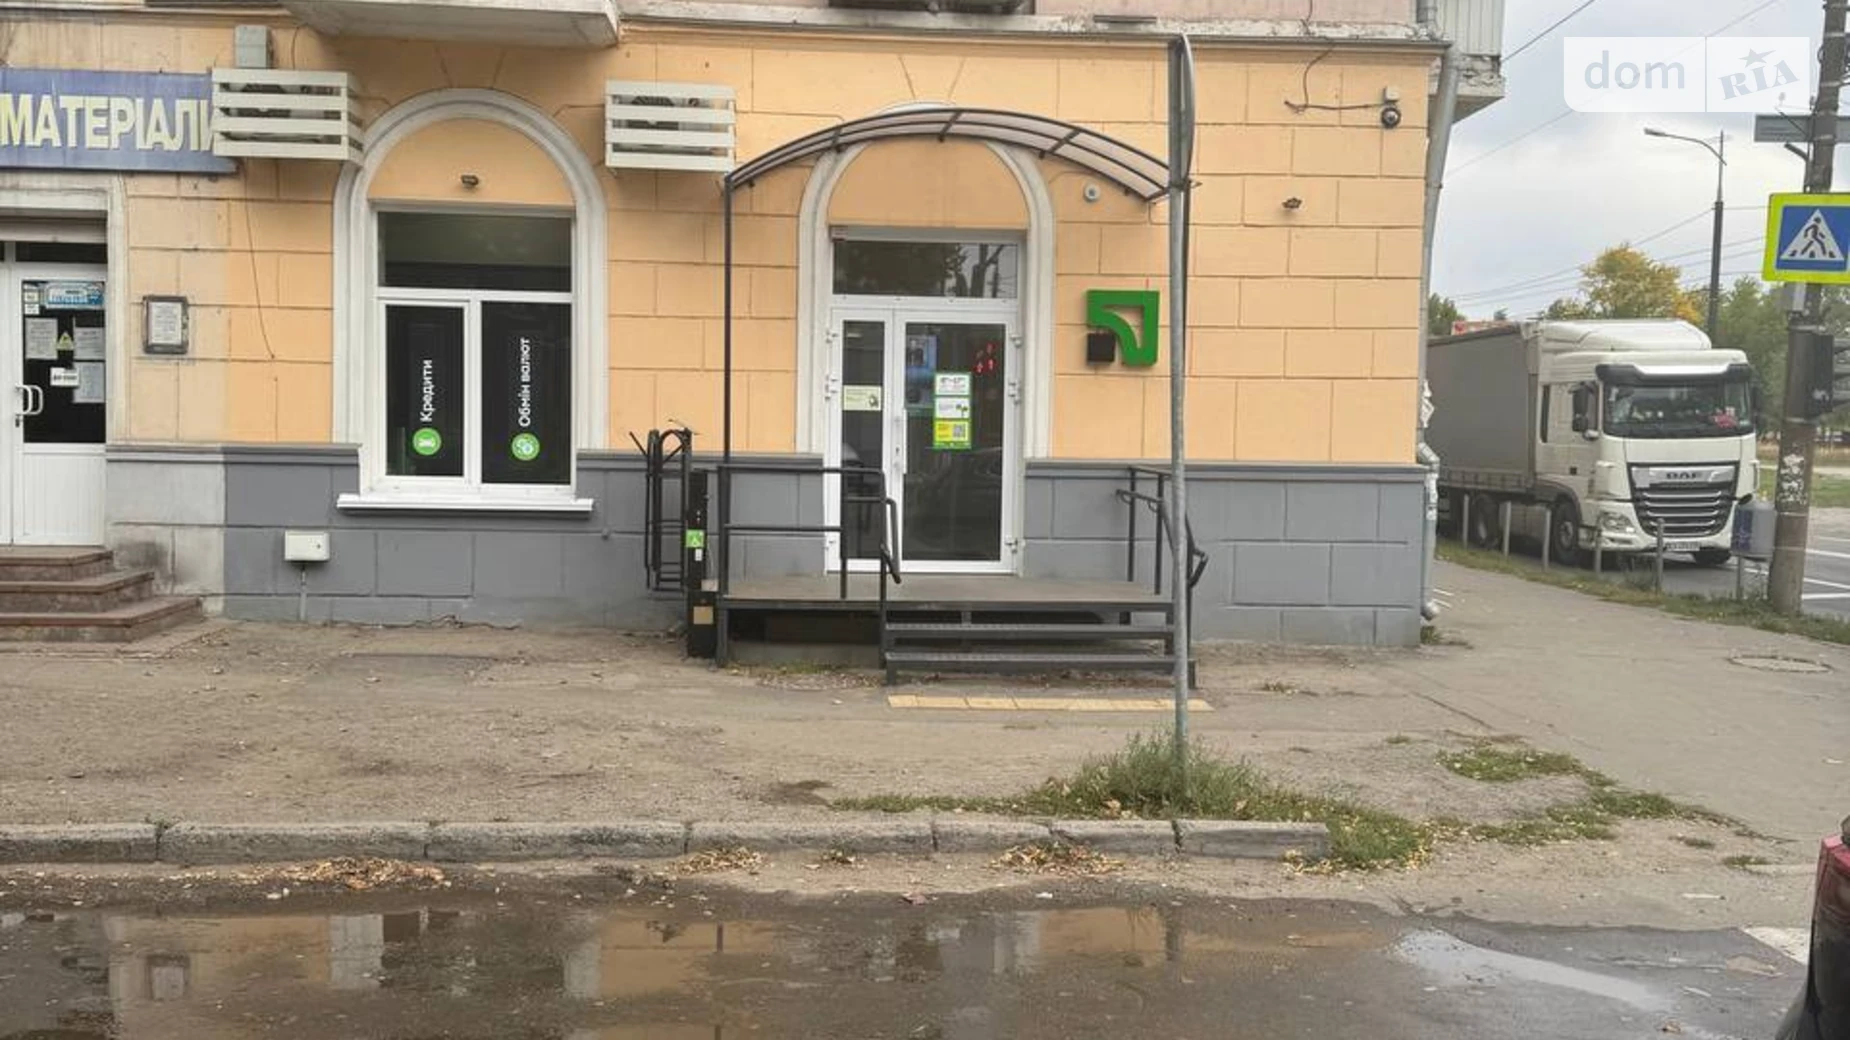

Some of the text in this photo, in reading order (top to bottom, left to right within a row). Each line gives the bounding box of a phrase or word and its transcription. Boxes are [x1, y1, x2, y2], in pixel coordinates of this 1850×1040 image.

[420, 359, 435, 422] Кредити
[518, 337, 531, 427] Обмін валют
